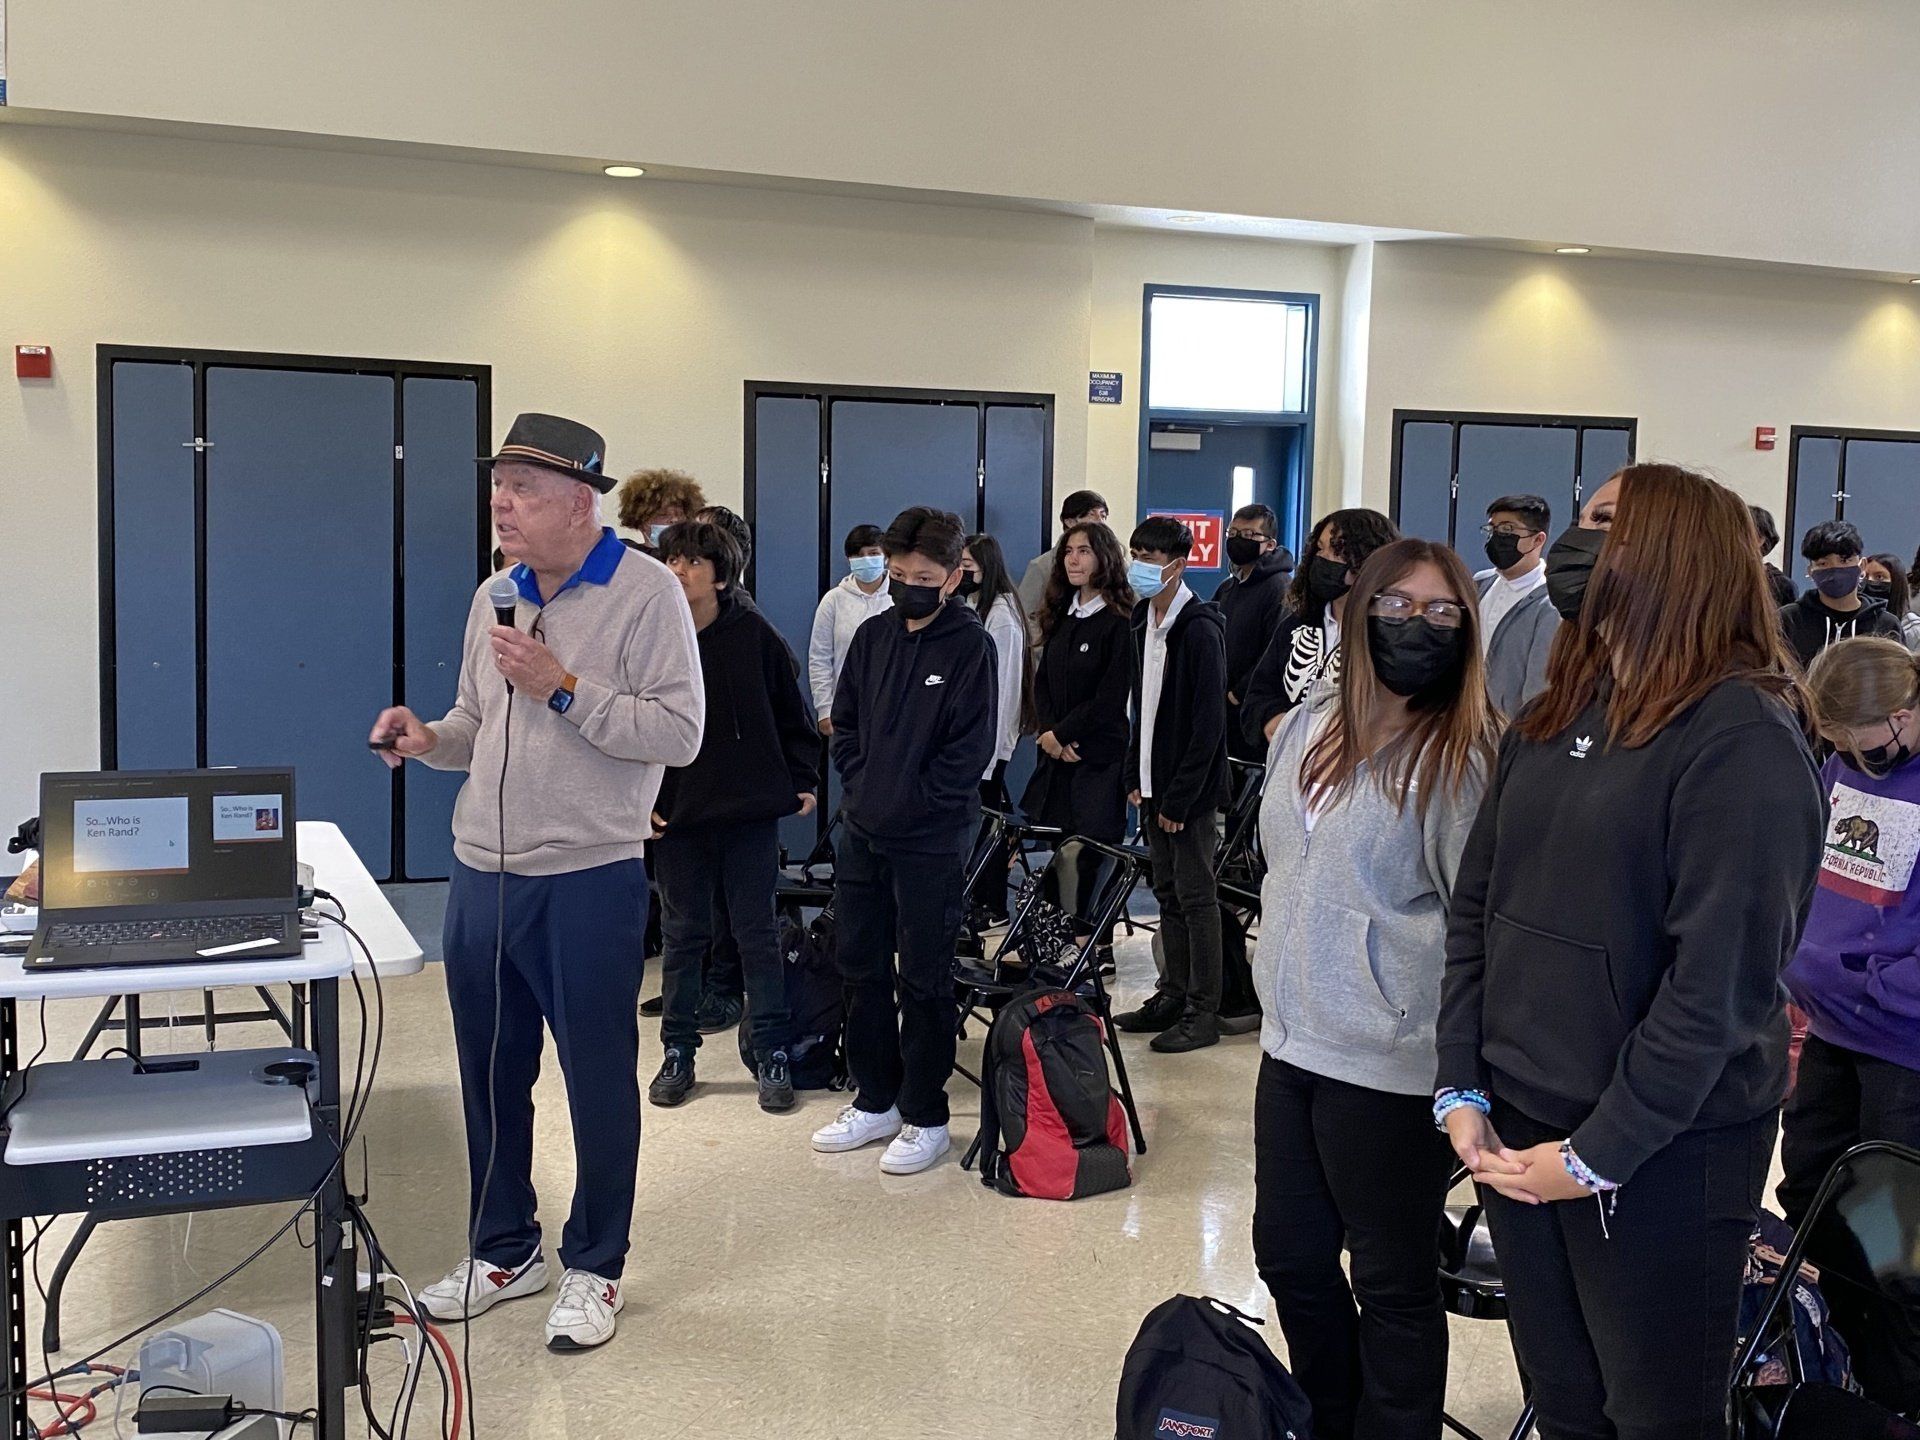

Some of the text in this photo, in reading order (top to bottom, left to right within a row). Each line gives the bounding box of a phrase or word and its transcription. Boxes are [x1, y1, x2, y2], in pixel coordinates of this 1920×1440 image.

[1184, 520, 1211, 540] IT
[1187, 543, 1214, 562] LY
[132, 816, 141, 825] is
[87, 827, 140, 837] Ken Rand?
[1823, 853, 1887, 883] FORNIA REPUBLIC
[1159, 1417, 1214, 1439] JANSPORT
